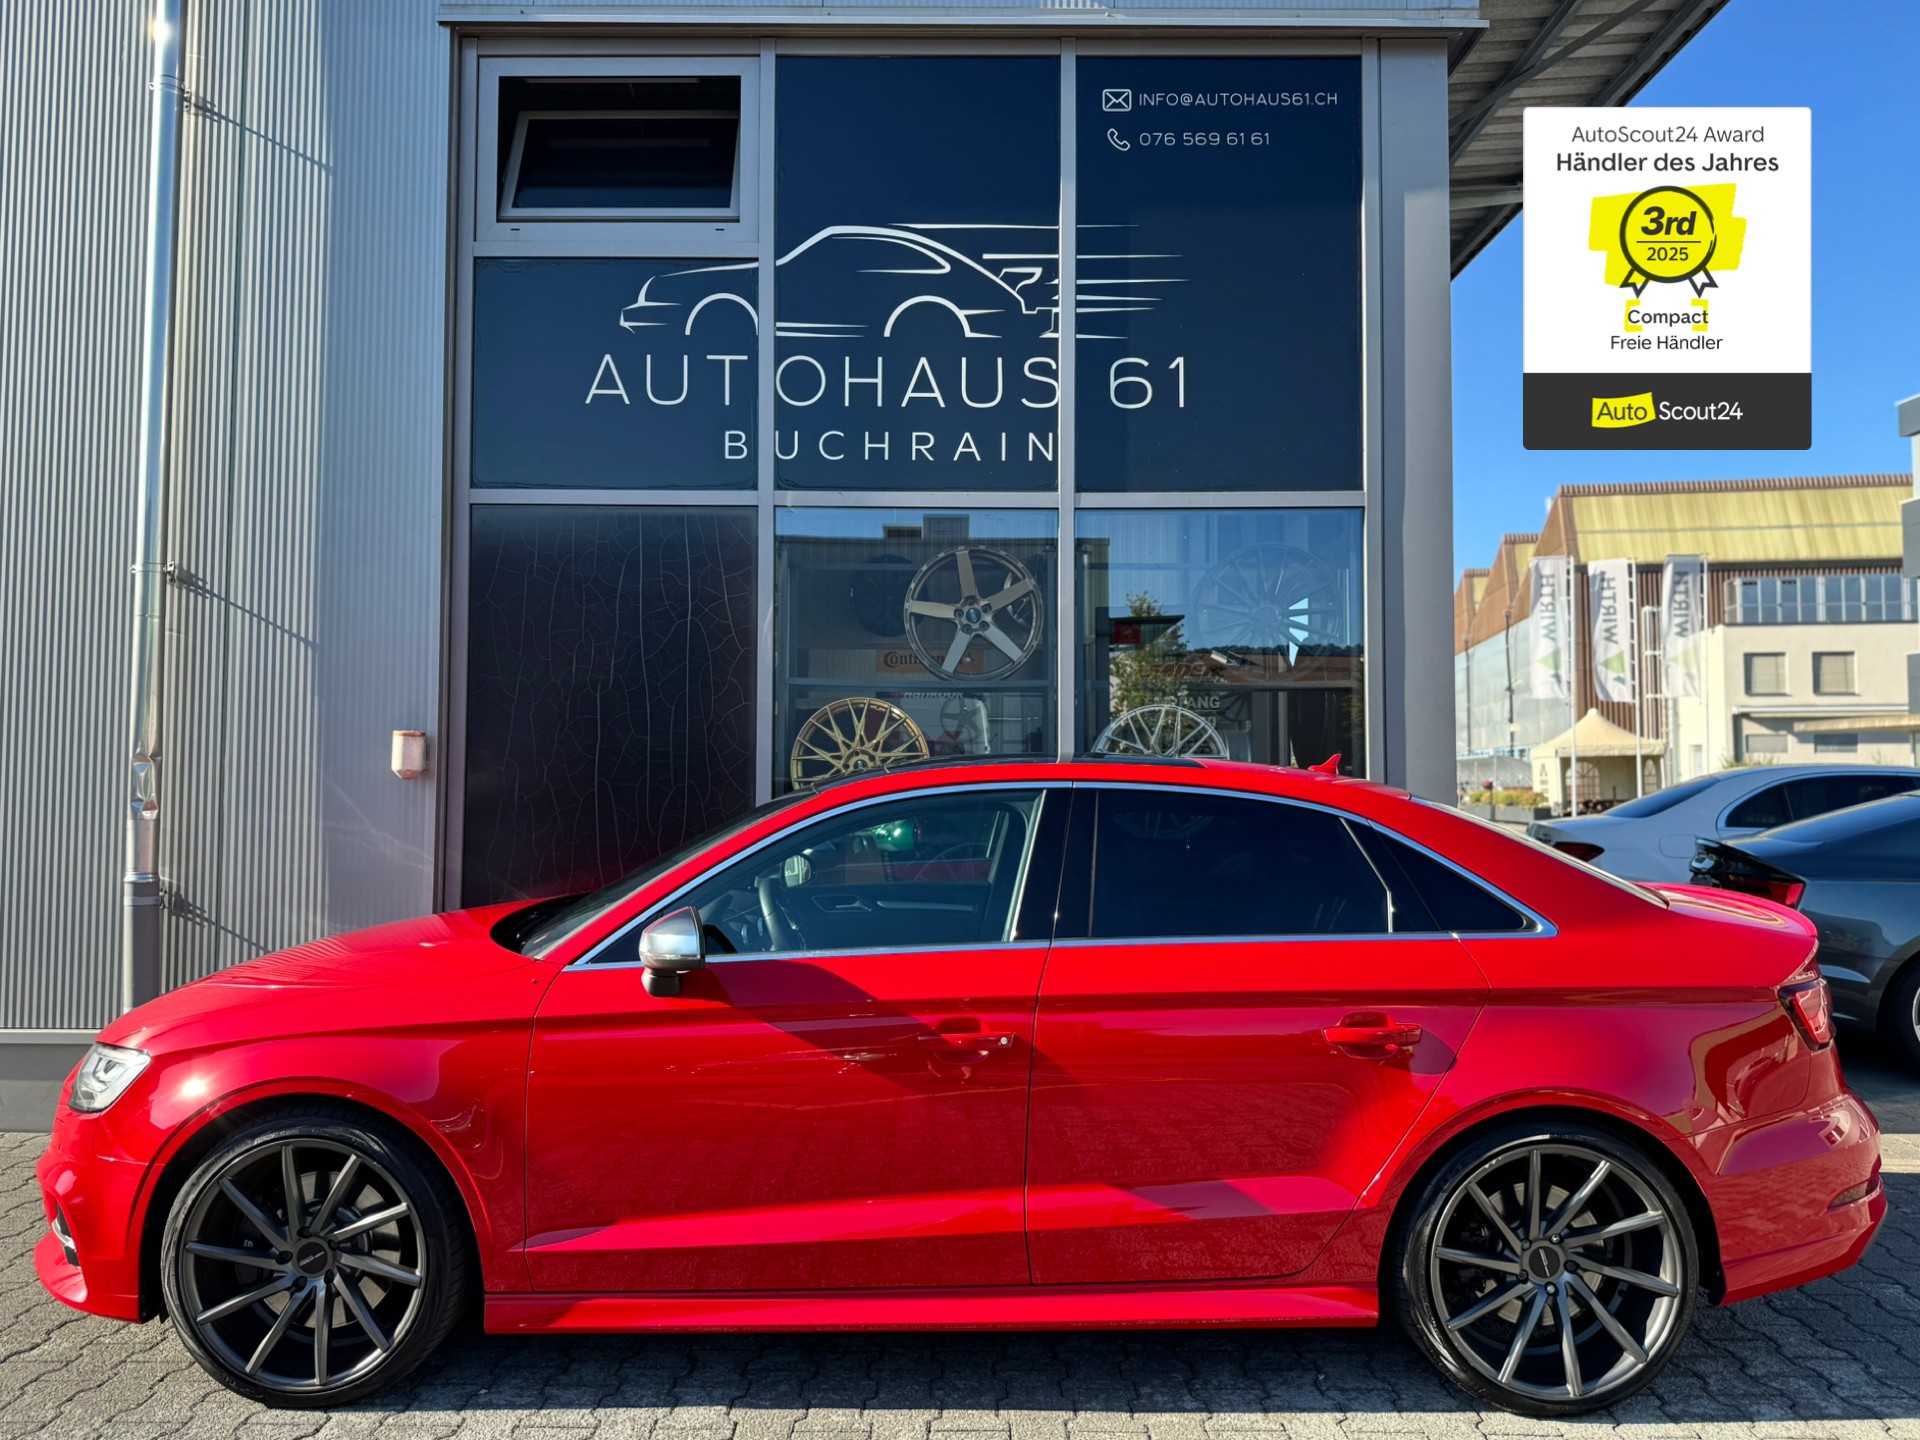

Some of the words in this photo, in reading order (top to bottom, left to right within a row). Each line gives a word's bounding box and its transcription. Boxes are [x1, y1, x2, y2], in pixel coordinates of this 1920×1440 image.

[1139, 92, 1338, 106] INFO@AUTOHAUS61.CH
[1139, 132, 1176, 146] 076
[1183, 132, 1220, 146] 569
[1226, 132, 1245, 146] 61
[1250, 132, 1269, 146] 61
[585, 354, 1059, 409] AUTOHAUS
[1109, 356, 1185, 409] 61
[724, 430, 1053, 462] BUCHRAIN
